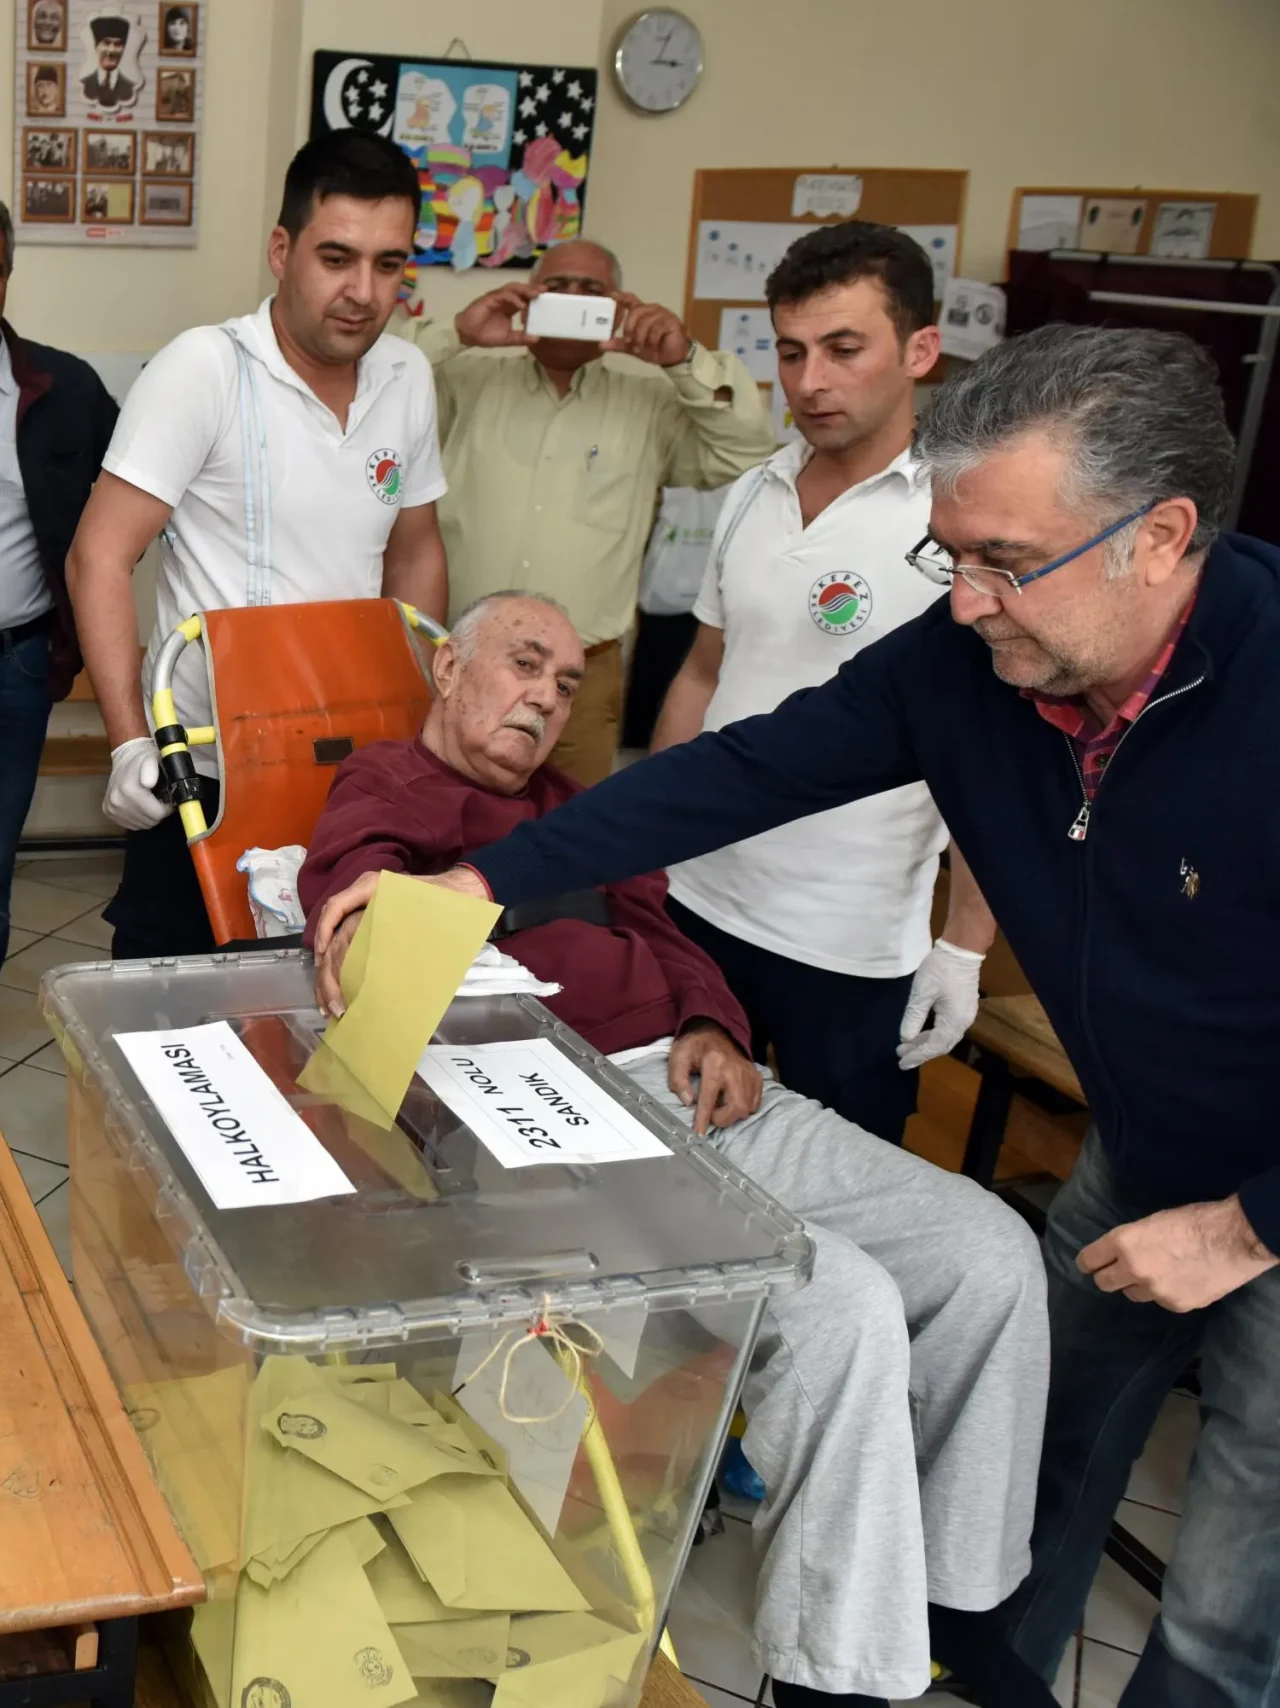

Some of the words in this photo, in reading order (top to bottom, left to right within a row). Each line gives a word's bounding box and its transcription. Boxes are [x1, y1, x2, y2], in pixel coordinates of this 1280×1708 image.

[818, 574, 869, 602] KEPEZ
[451, 1058, 504, 1094] NOLU
[161, 1044, 280, 1183] HALKOYLAMASI
[518, 1072, 590, 1126] SANDIK
[496, 1107, 562, 1149] 2311
